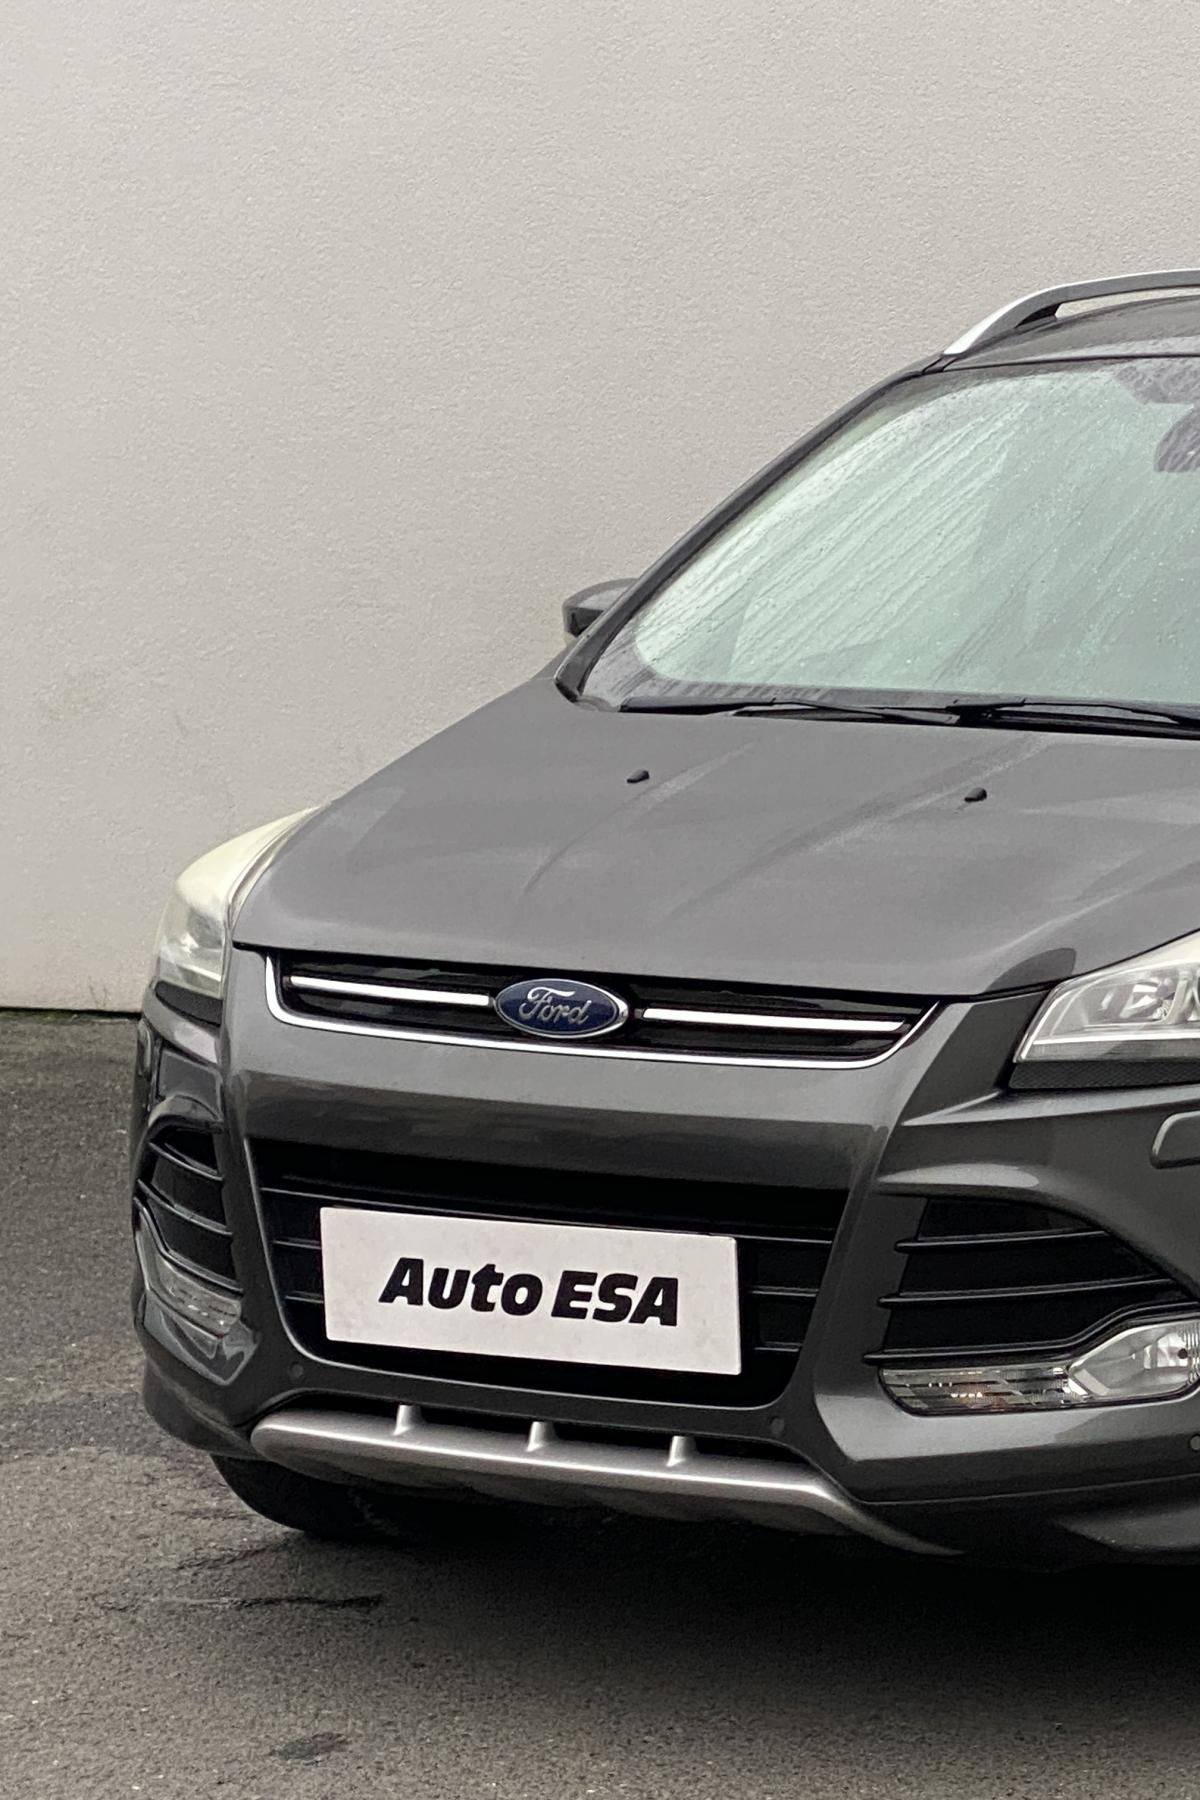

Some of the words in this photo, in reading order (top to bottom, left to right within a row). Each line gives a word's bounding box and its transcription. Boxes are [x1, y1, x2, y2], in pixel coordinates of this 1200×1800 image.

[518, 986, 592, 1025] Ford
[378, 1257, 543, 1316] Auto
[550, 1270, 679, 1327] ESA
